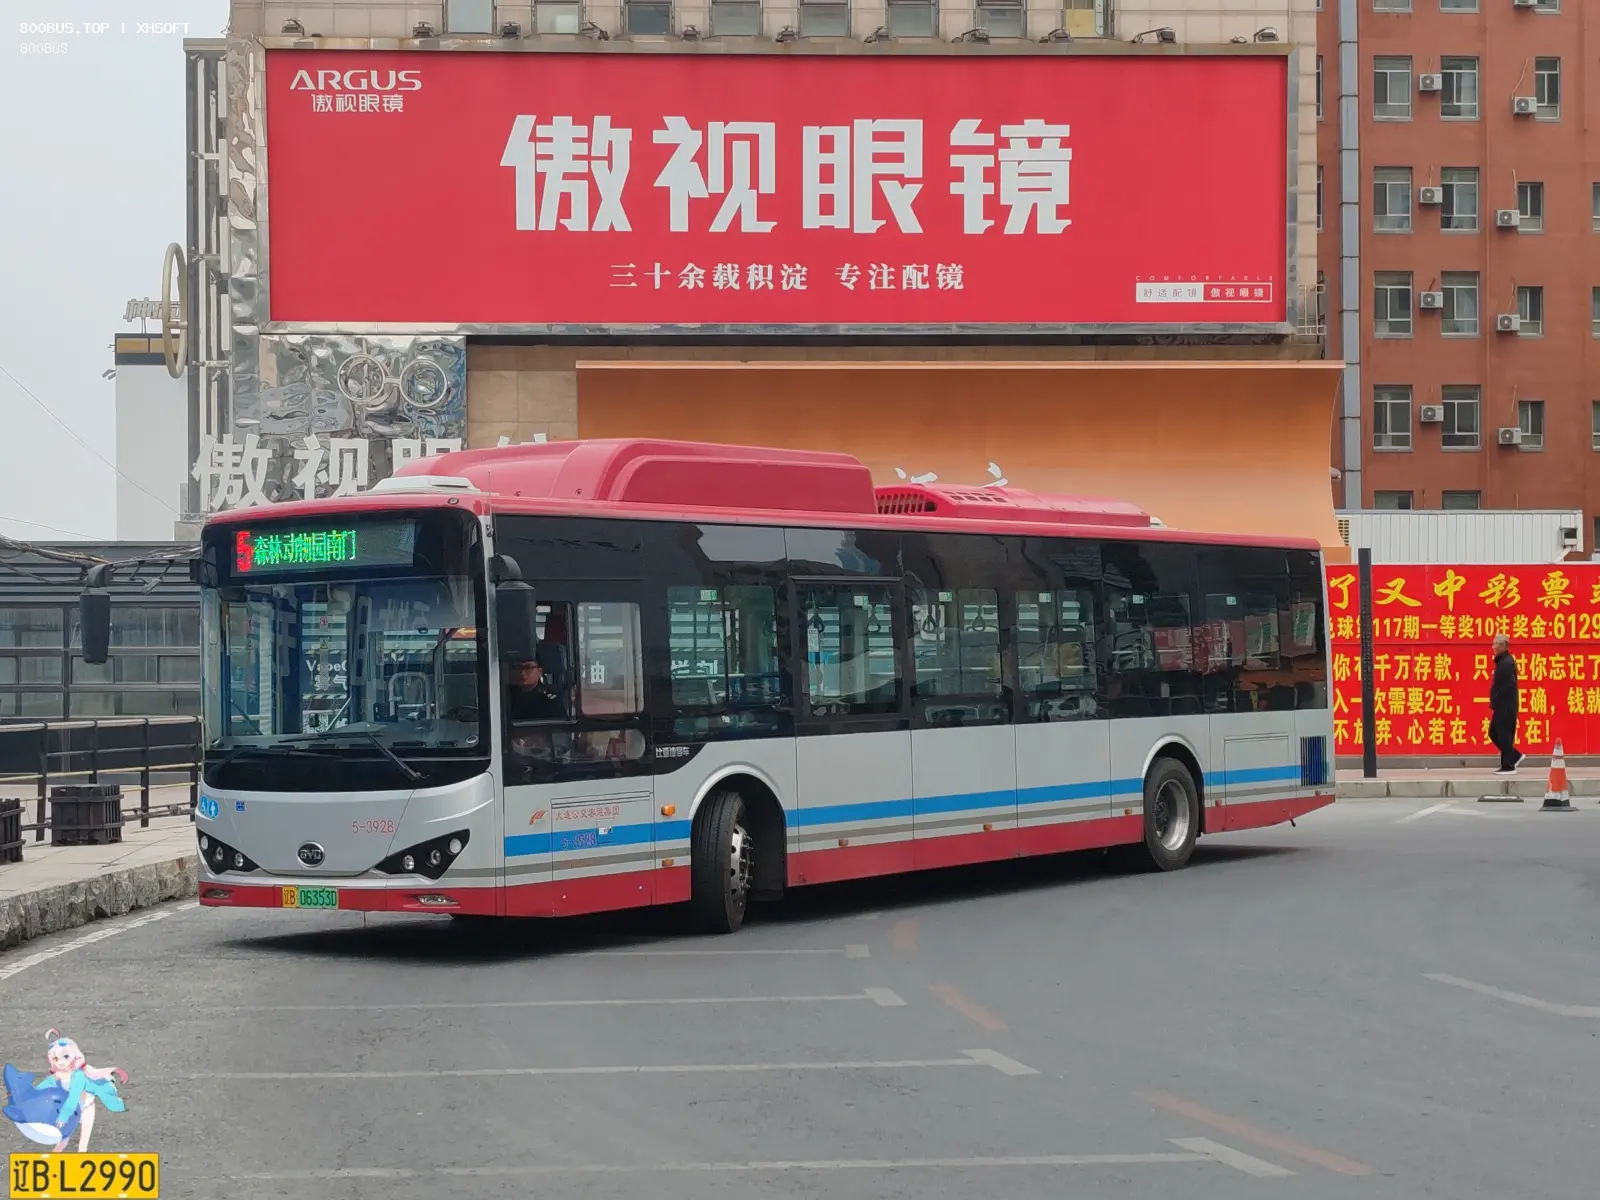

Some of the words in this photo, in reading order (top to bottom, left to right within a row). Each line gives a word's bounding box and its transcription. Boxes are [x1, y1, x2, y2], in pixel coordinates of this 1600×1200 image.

[289, 70, 422, 91] ARGUS
[311, 94, 404, 112] 傲视眼镜
[500, 114, 1073, 235] 傲视眼镜
[609, 263, 808, 291] 三十余载积淀
[835, 263, 965, 291] 专注配镜
[236, 530, 253, 572] 5
[1329, 569, 1600, 611] 了又中彩票
[351, 820, 395, 833] 5-3928
